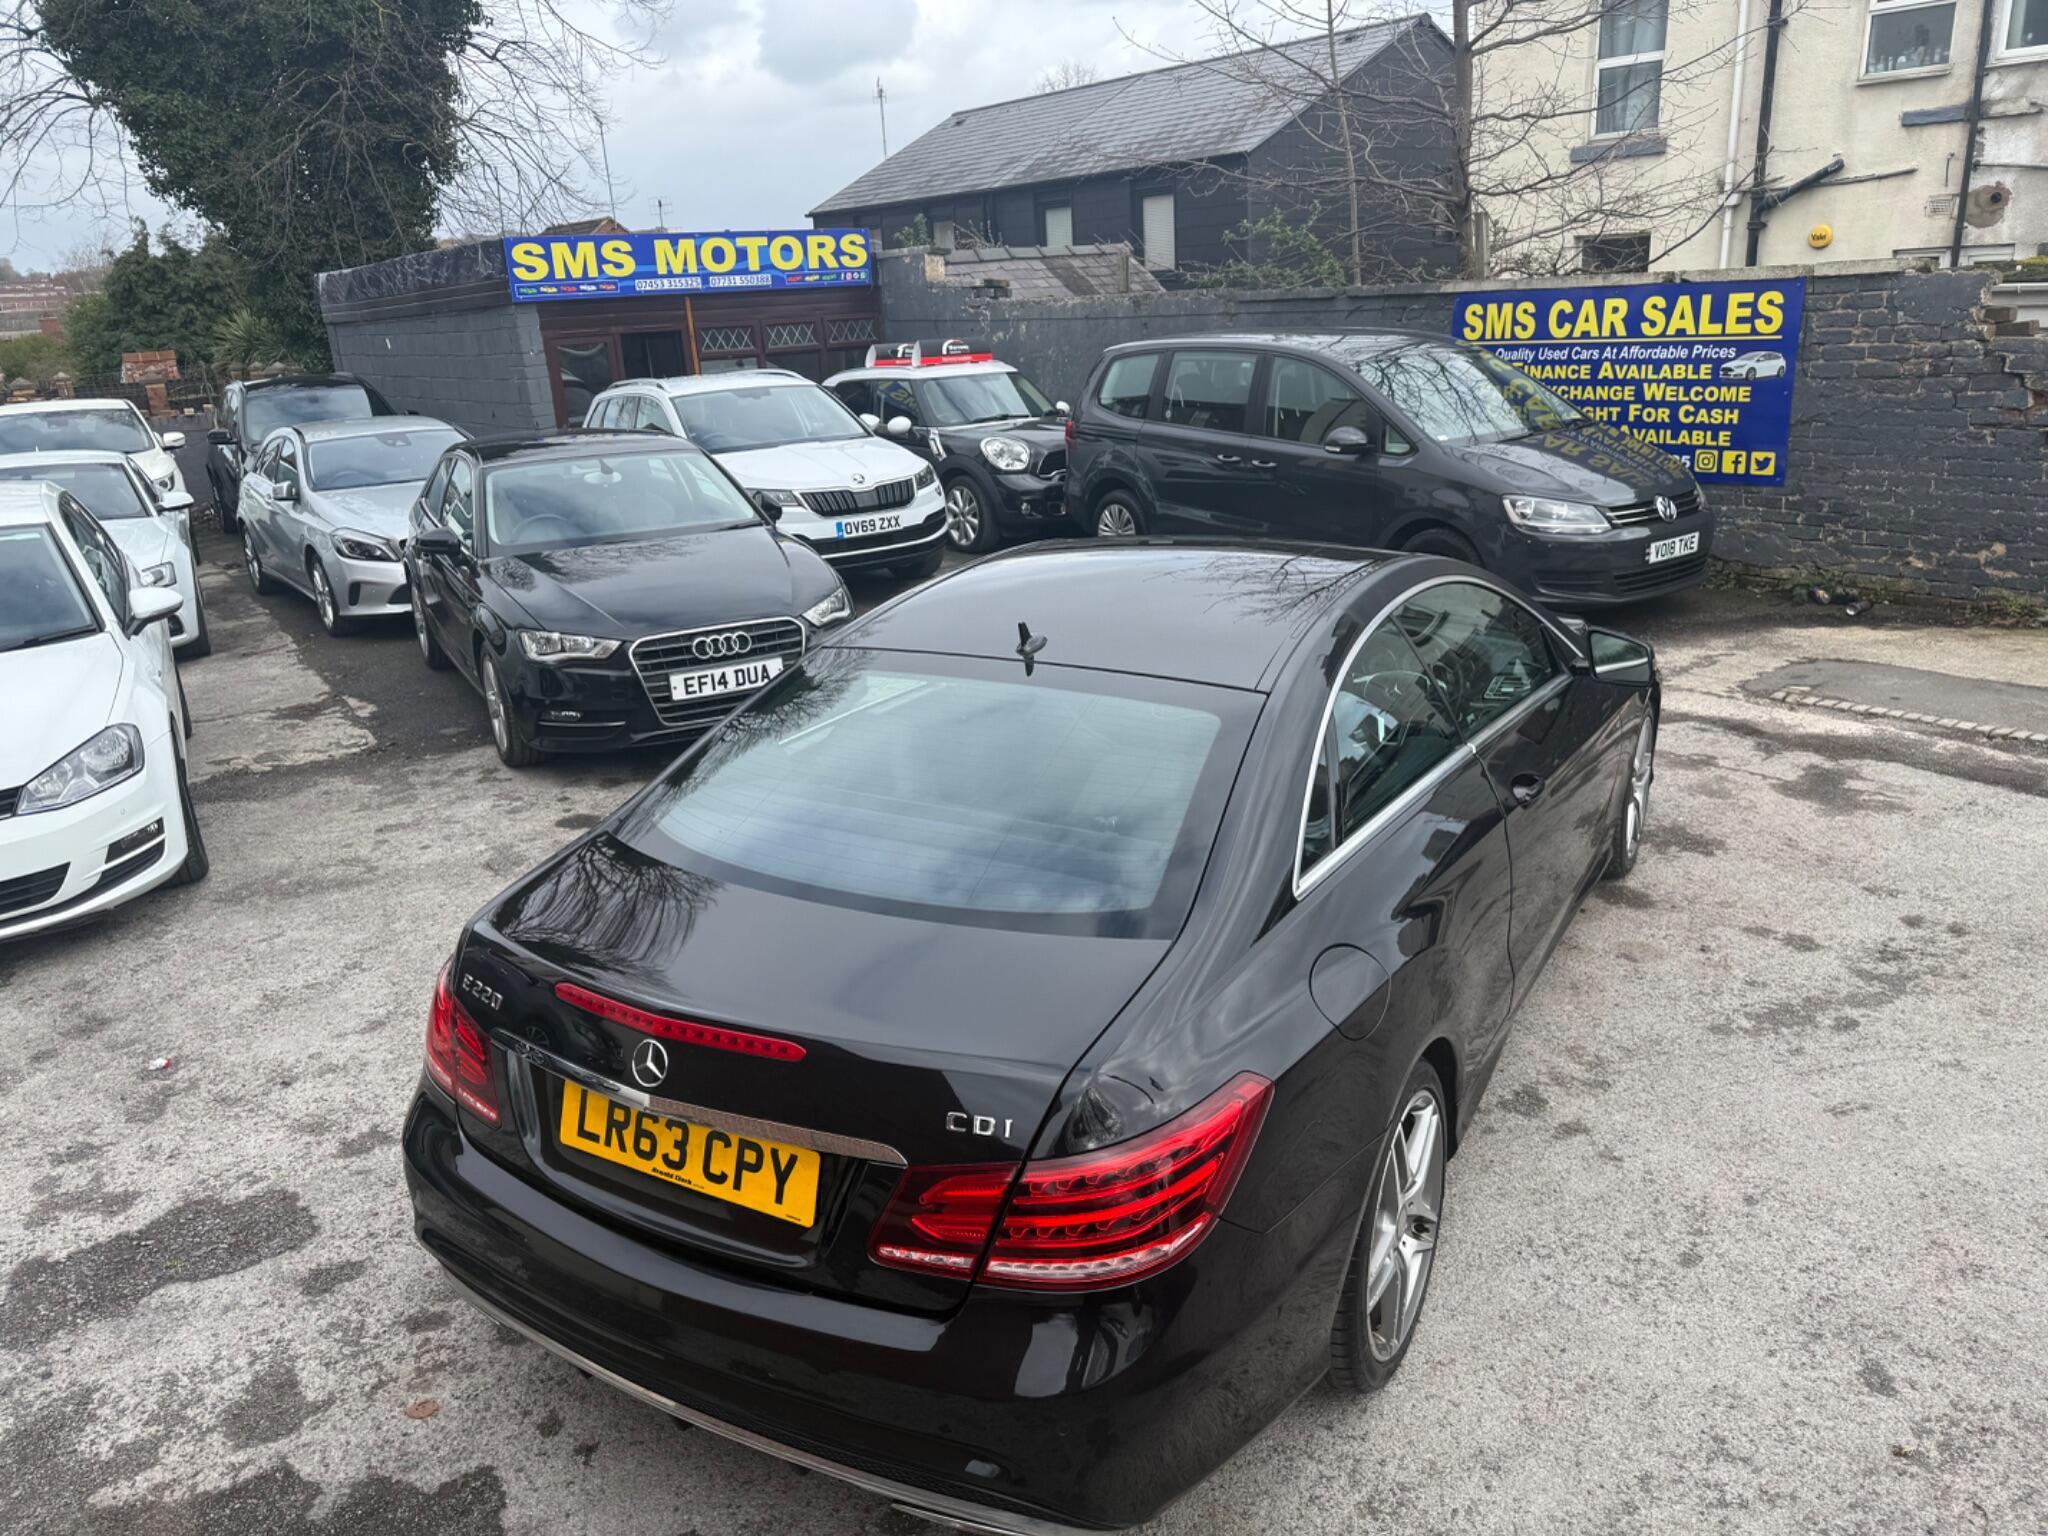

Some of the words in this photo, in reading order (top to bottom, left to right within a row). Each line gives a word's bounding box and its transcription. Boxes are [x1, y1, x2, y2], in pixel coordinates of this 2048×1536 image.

[511, 240, 637, 281] SMS
[653, 233, 869, 275] MOTORS
[1463, 301, 1536, 341] SMS
[1548, 298, 1629, 338] CAR
[1640, 291, 1785, 336] SALES
[1495, 347, 1536, 363] Quality
[1538, 347, 1569, 360] Used
[1571, 347, 1600, 360] Cars
[1602, 346, 1618, 359] At
[1619, 344, 1689, 360] Affordable
[1691, 344, 1736, 359] Prices
[1597, 361, 1712, 379] AVAILABLE
[1643, 382, 1752, 402] WELCOME
[1628, 404, 1671, 423] FOR
[1678, 405, 1740, 424] CASH
[844, 520, 876, 535] OV69
[879, 515, 901, 530] ZXX
[1679, 534, 1696, 554] TKE
[683, 671, 729, 695] EF14
[733, 663, 771, 687] DUA
[945, 1111, 1014, 1139] CDI
[577, 1090, 690, 1171] LR63
[702, 1130, 798, 1205] CPY
